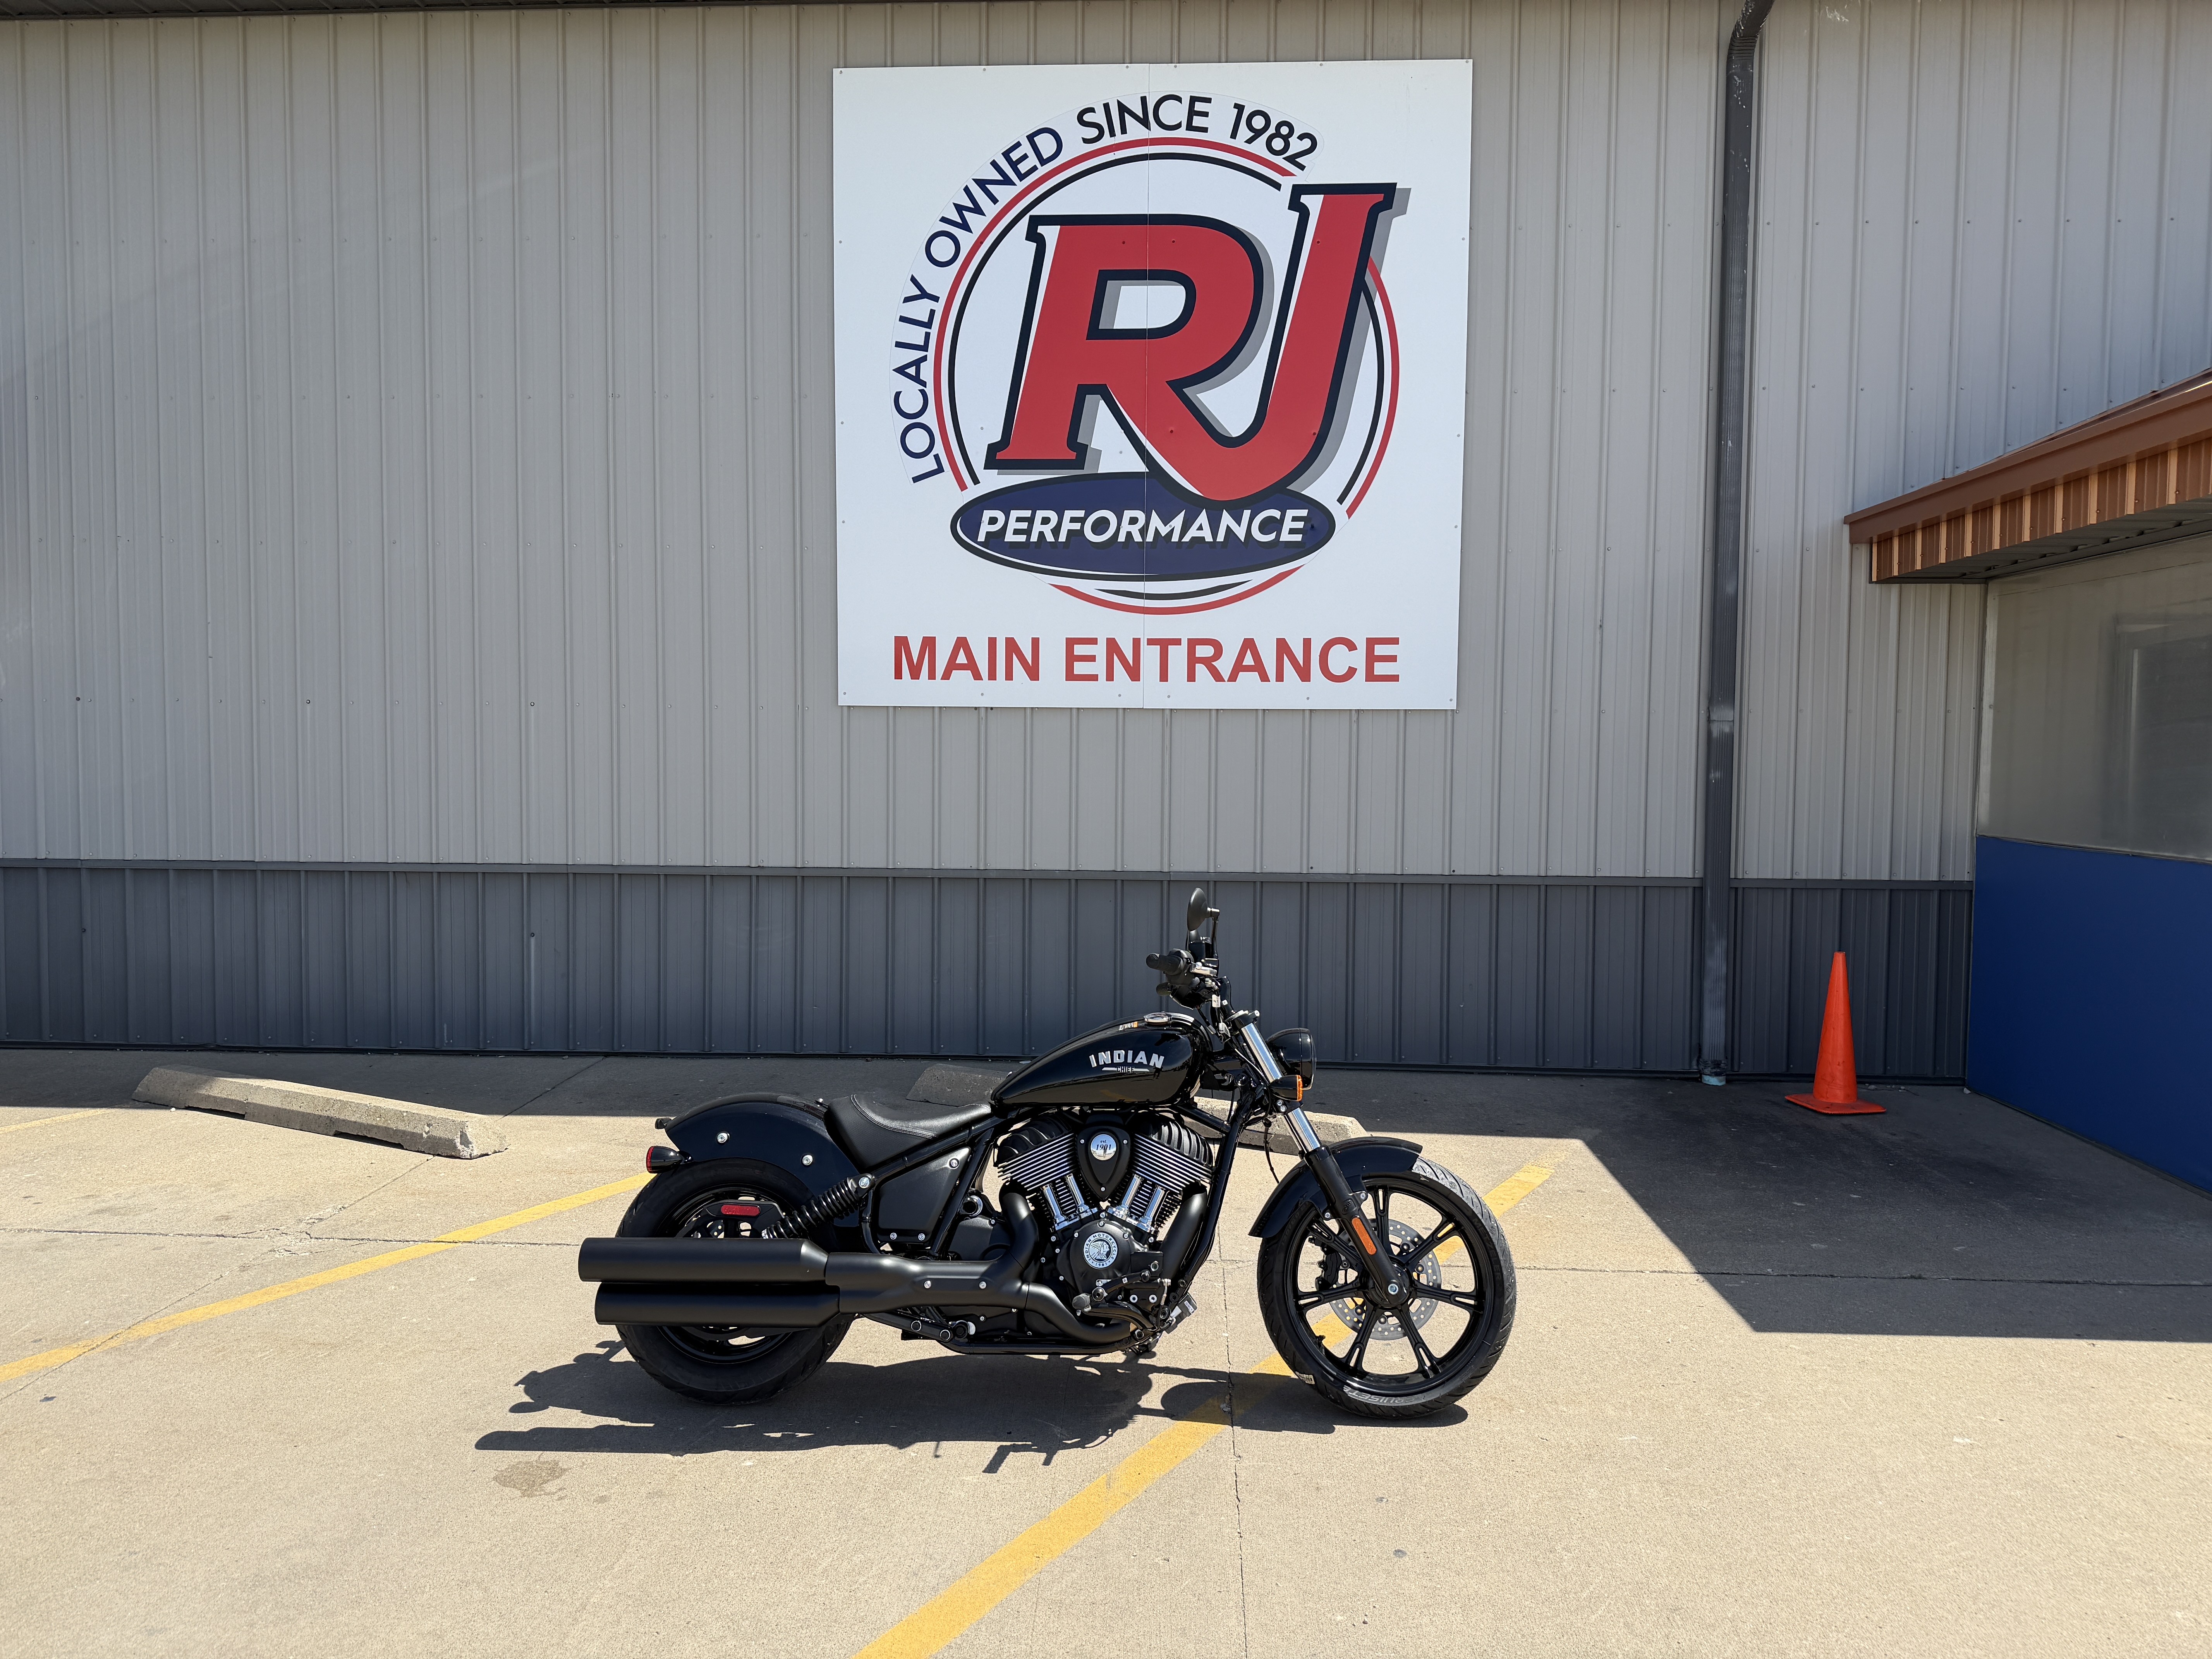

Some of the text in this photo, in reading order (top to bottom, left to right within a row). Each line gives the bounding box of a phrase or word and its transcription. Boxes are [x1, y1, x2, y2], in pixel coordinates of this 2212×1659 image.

[892, 94, 1318, 484] LOCALLY OWNED SINCE 1982
[984, 182, 1398, 505] RJ
[977, 508, 1309, 543] PERFORMANCE
[894, 636, 1399, 683] MAIN ENTRANCE
[1089, 1050, 1164, 1069] INDIAN
[1093, 1233, 1116, 1260] MOTORCYCLE
[1472, 1218, 1502, 1280] METZELER
